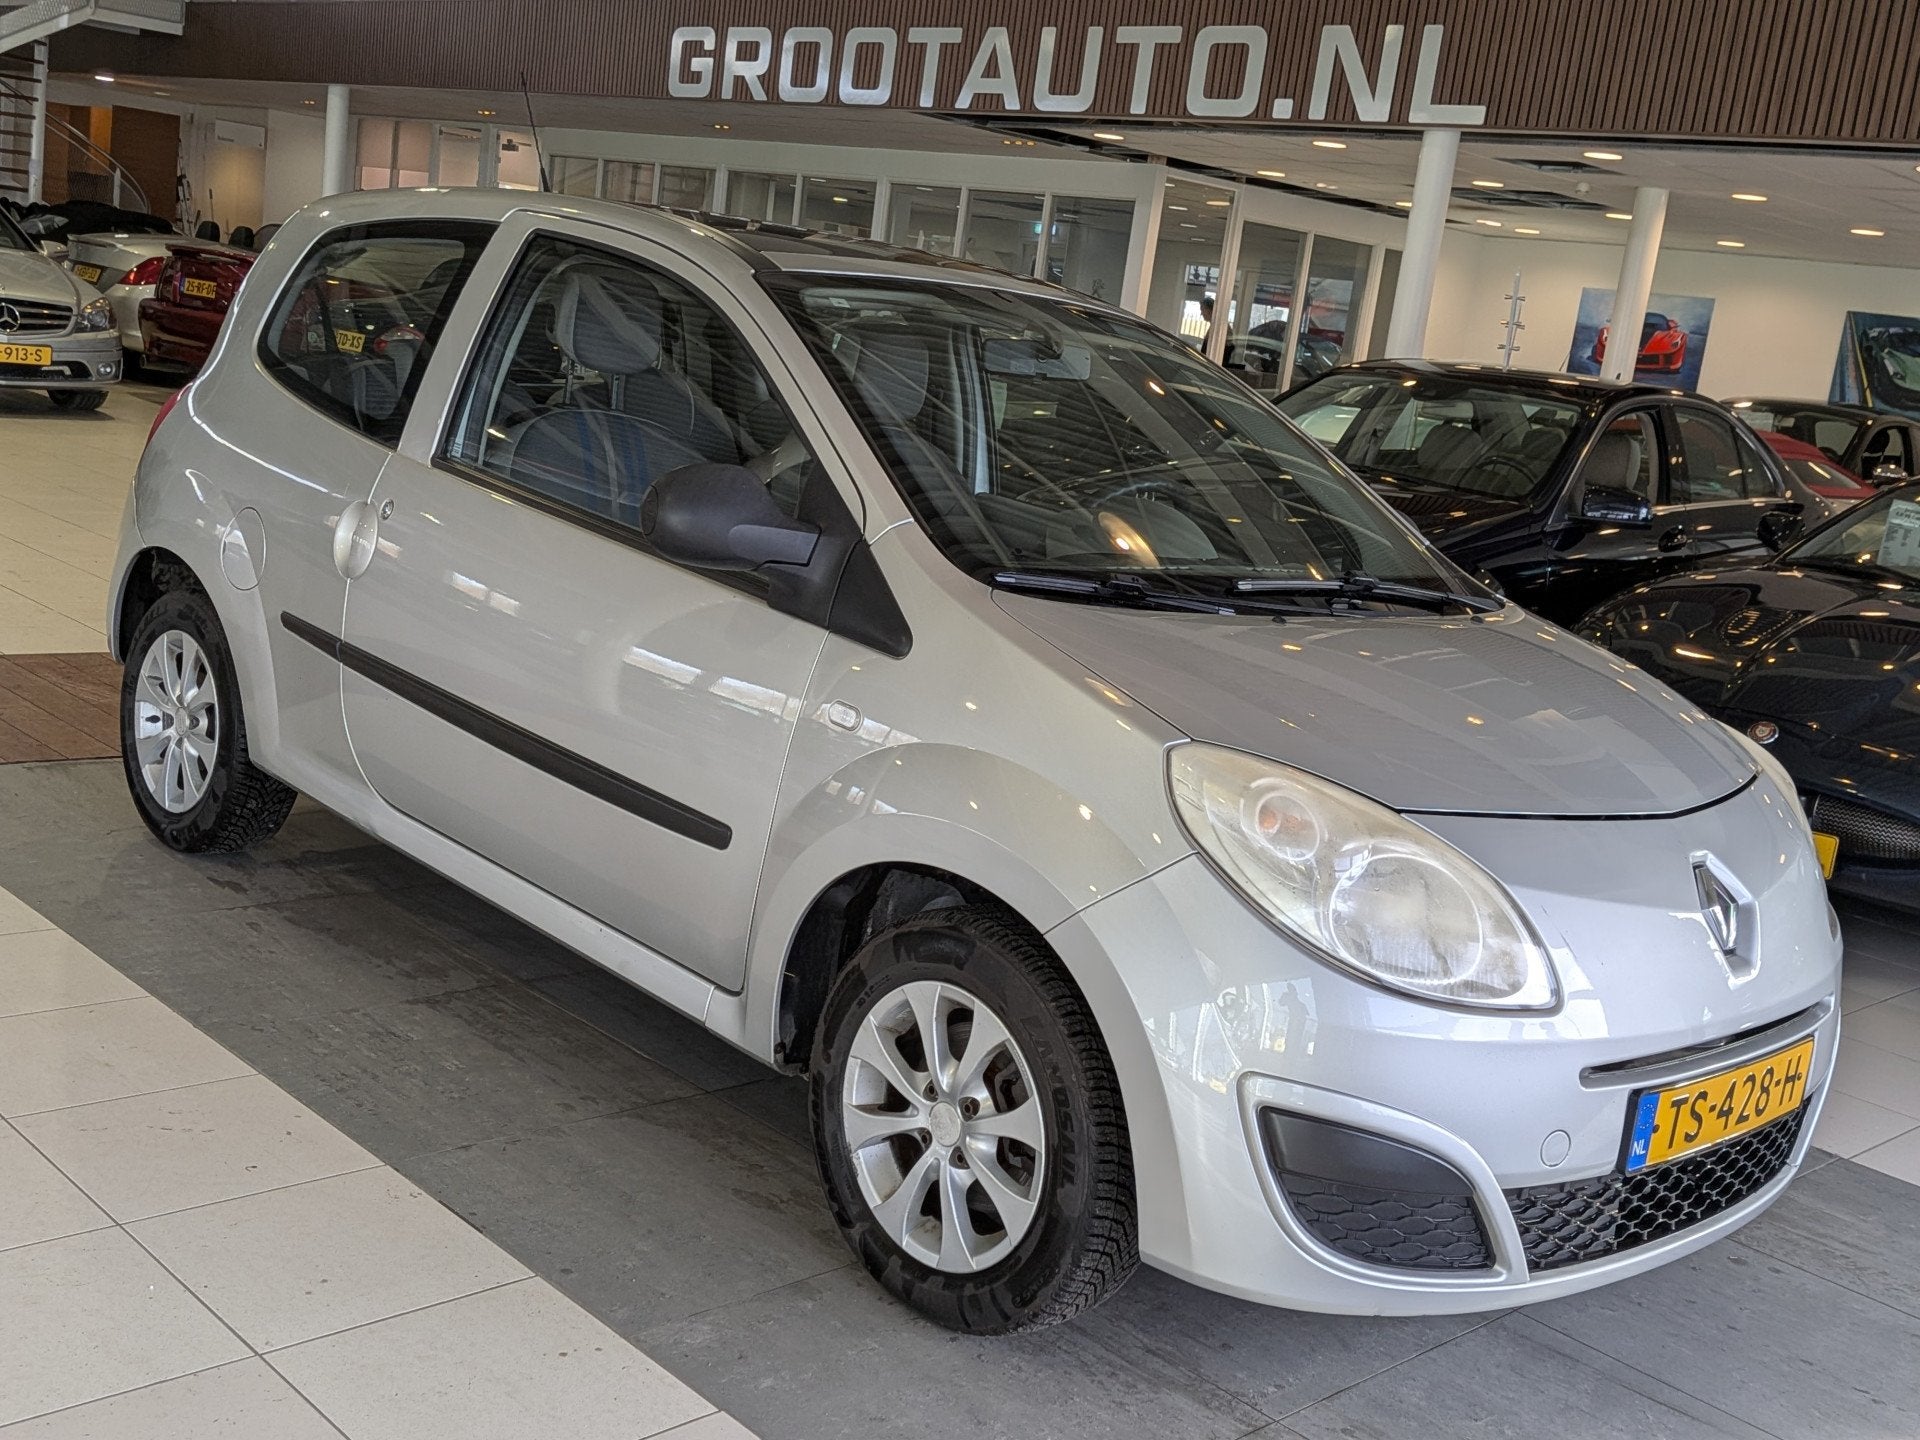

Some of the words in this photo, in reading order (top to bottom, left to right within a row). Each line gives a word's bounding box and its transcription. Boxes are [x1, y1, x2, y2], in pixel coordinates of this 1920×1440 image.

[668, 25, 1486, 125] GROOTAUTO.NL
[1632, 1139, 1646, 1157] NL
[1668, 1055, 1802, 1149] TS-428-H
